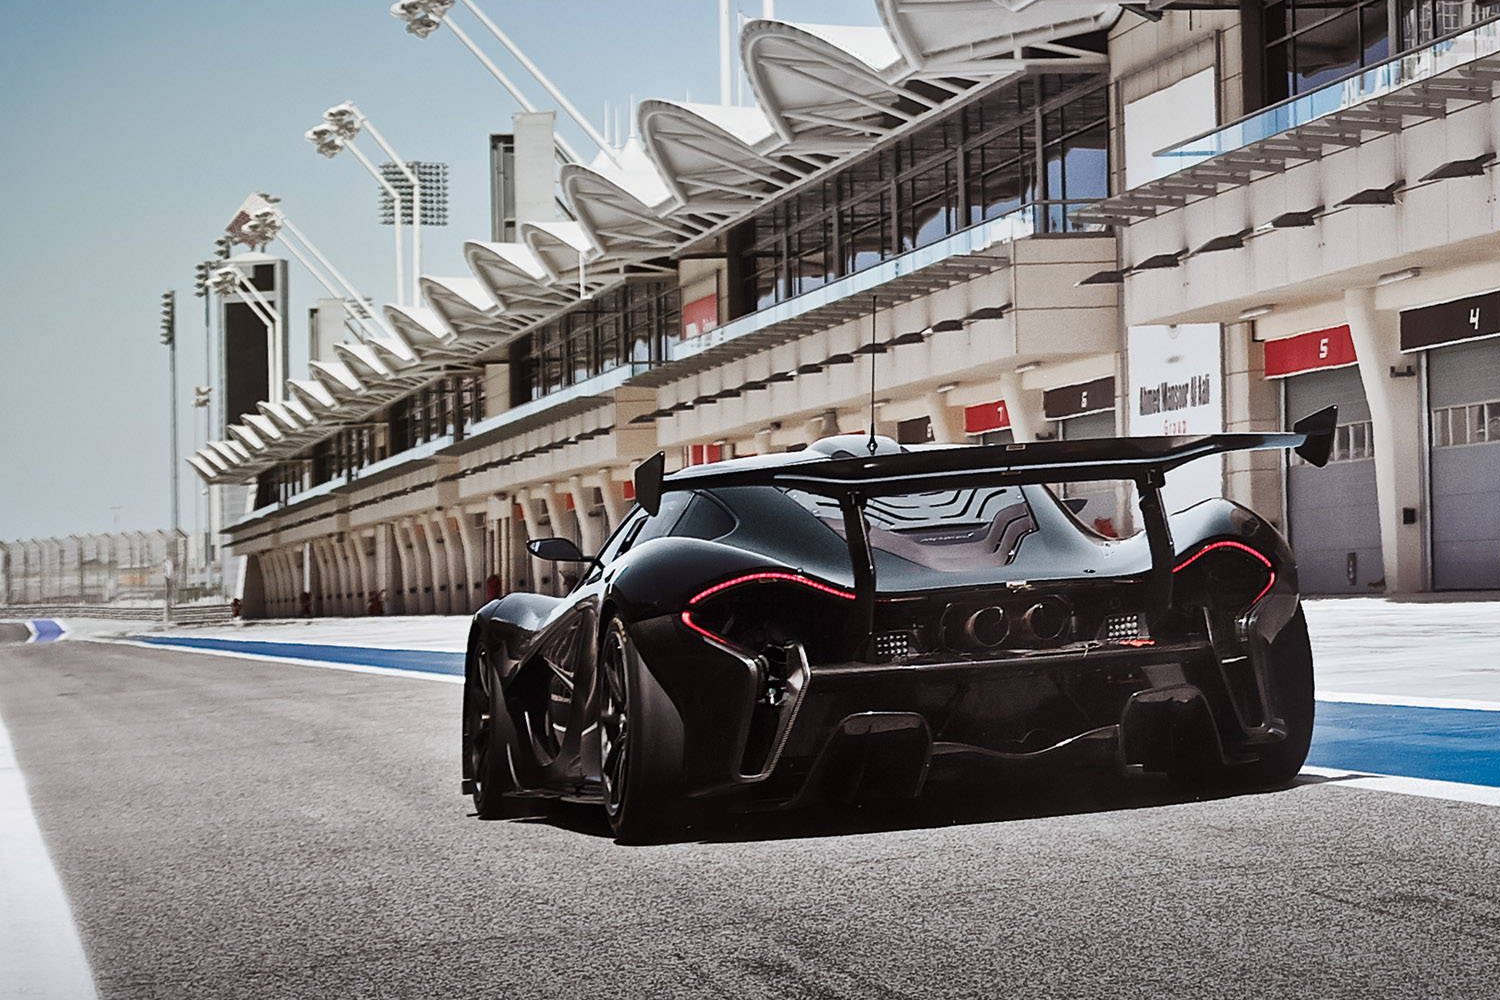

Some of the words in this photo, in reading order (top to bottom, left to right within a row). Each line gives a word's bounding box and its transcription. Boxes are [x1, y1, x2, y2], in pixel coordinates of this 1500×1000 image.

[1469, 307, 1480, 330] 4
[1319, 338, 1329, 359] 5
[1081, 391, 1088, 408] 6
[997, 406, 1004, 422] 7
